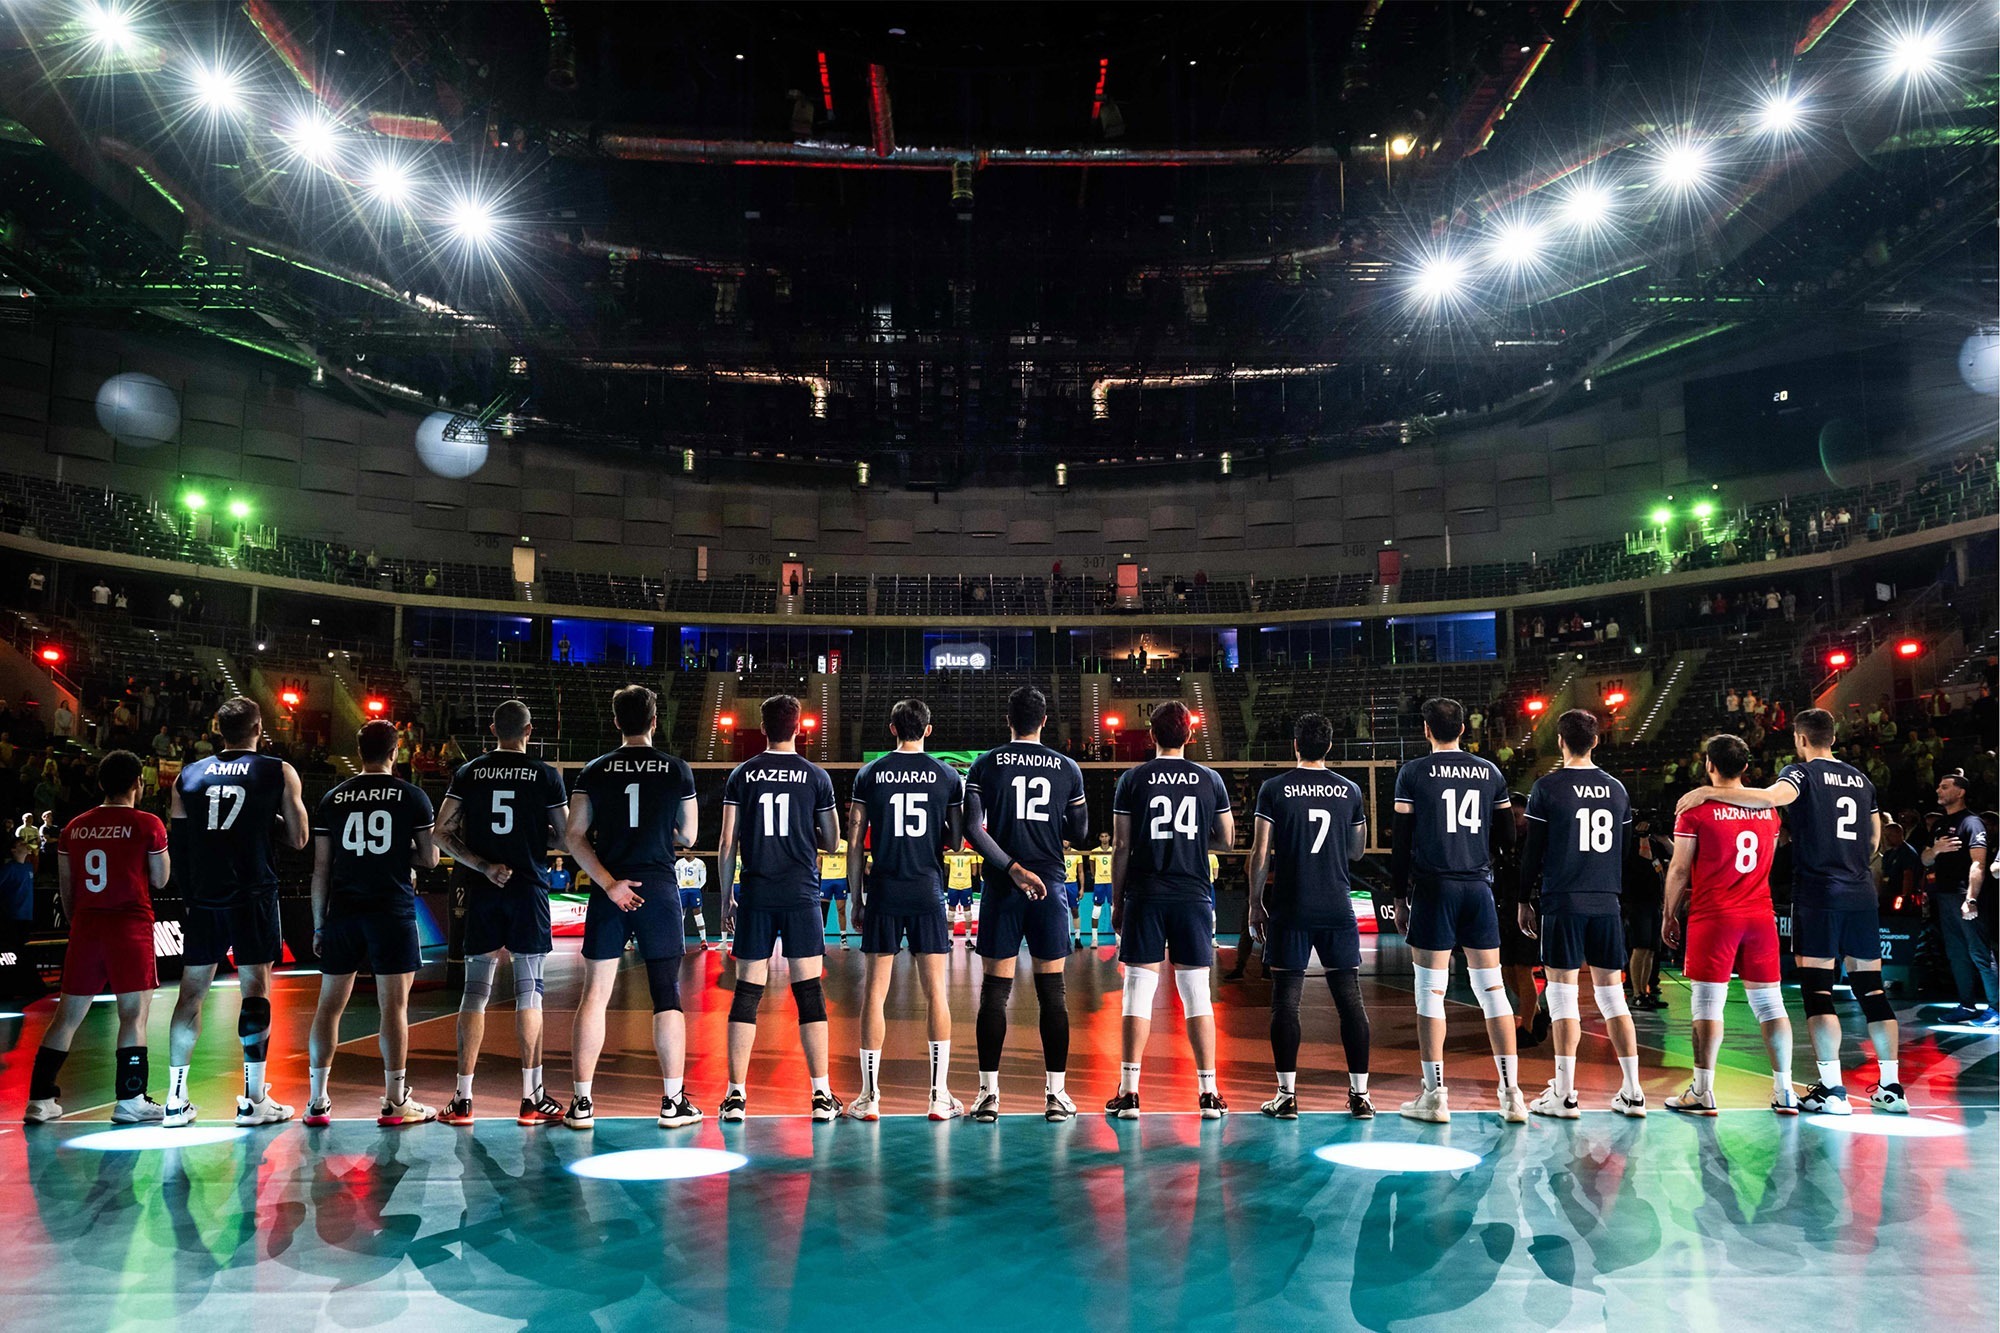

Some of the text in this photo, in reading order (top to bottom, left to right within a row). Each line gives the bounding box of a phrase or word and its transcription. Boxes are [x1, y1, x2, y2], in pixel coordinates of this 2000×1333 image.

[936, 652, 968, 669] plus
[281, 677, 310, 695] 1-04
[1595, 678, 1624, 697] 1-07
[1137, 703, 1158, 718] 1-0
[604, 760, 670, 773] JELVEH
[996, 749, 1062, 770] ESFANDIAR
[204, 762, 250, 776] AMIN
[473, 767, 537, 782] TOUKHTEH
[745, 769, 808, 784] KAZEMI
[875, 771, 937, 784] MOJARAD
[1429, 765, 1490, 781] J.MANAVI
[1148, 772, 1200, 785] JAVAD
[1824, 772, 1864, 789] MILAD
[334, 788, 402, 804] SHARIFI
[1011, 776, 1052, 822] 12
[1284, 784, 1348, 799] SHAHROOZ
[1572, 785, 1611, 799] VADI
[205, 784, 246, 831] 17
[491, 790, 515, 835] 5
[625, 783, 640, 828] 1
[1441, 789, 1482, 834] 14
[758, 792, 790, 837] 11
[889, 793, 929, 838] 15
[1150, 796, 1199, 840] 24
[1836, 797, 1858, 841] 2
[71, 825, 132, 840] MOAZZEN
[342, 810, 393, 857] 49
[1308, 808, 1332, 854] 7
[1576, 808, 1614, 853] 18
[1735, 830, 1759, 874] 8
[1066, 859, 1072, 869] 8
[1102, 856, 1109, 866] 6
[85, 848, 108, 893] 9
[684, 866, 694, 876] 15
